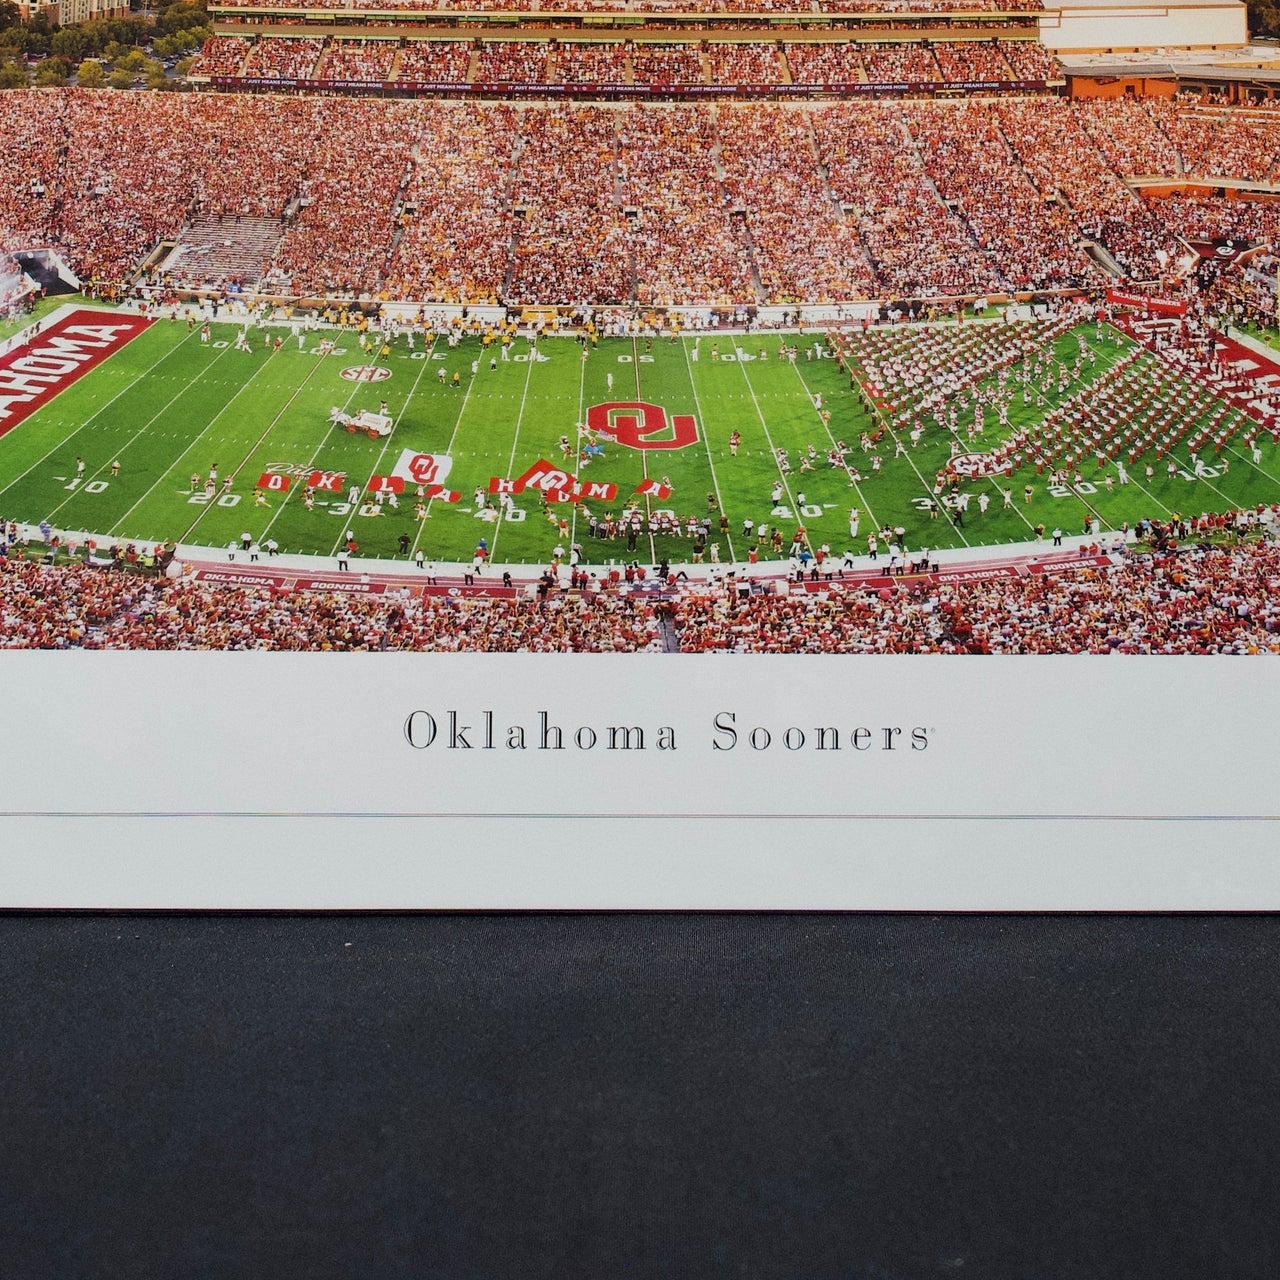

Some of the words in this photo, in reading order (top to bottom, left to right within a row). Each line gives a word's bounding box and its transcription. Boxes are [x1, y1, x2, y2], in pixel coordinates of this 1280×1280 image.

[586, 401, 701, 450] OU
[408, 454, 439, 483] OU
[63, 478, 110, 493] 10
[380, 478, 393, 491] L
[497, 479, 514, 493] H
[588, 483, 610, 498] M
[770, 505, 823, 519] 40
[203, 572, 275, 586] OKLAHOMA
[938, 568, 1012, 582] OKLAHOMA
[310, 581, 370, 592] SOONERS
[402, 709, 678, 752] Oklahoma
[712, 710, 931, 752] Sooners
